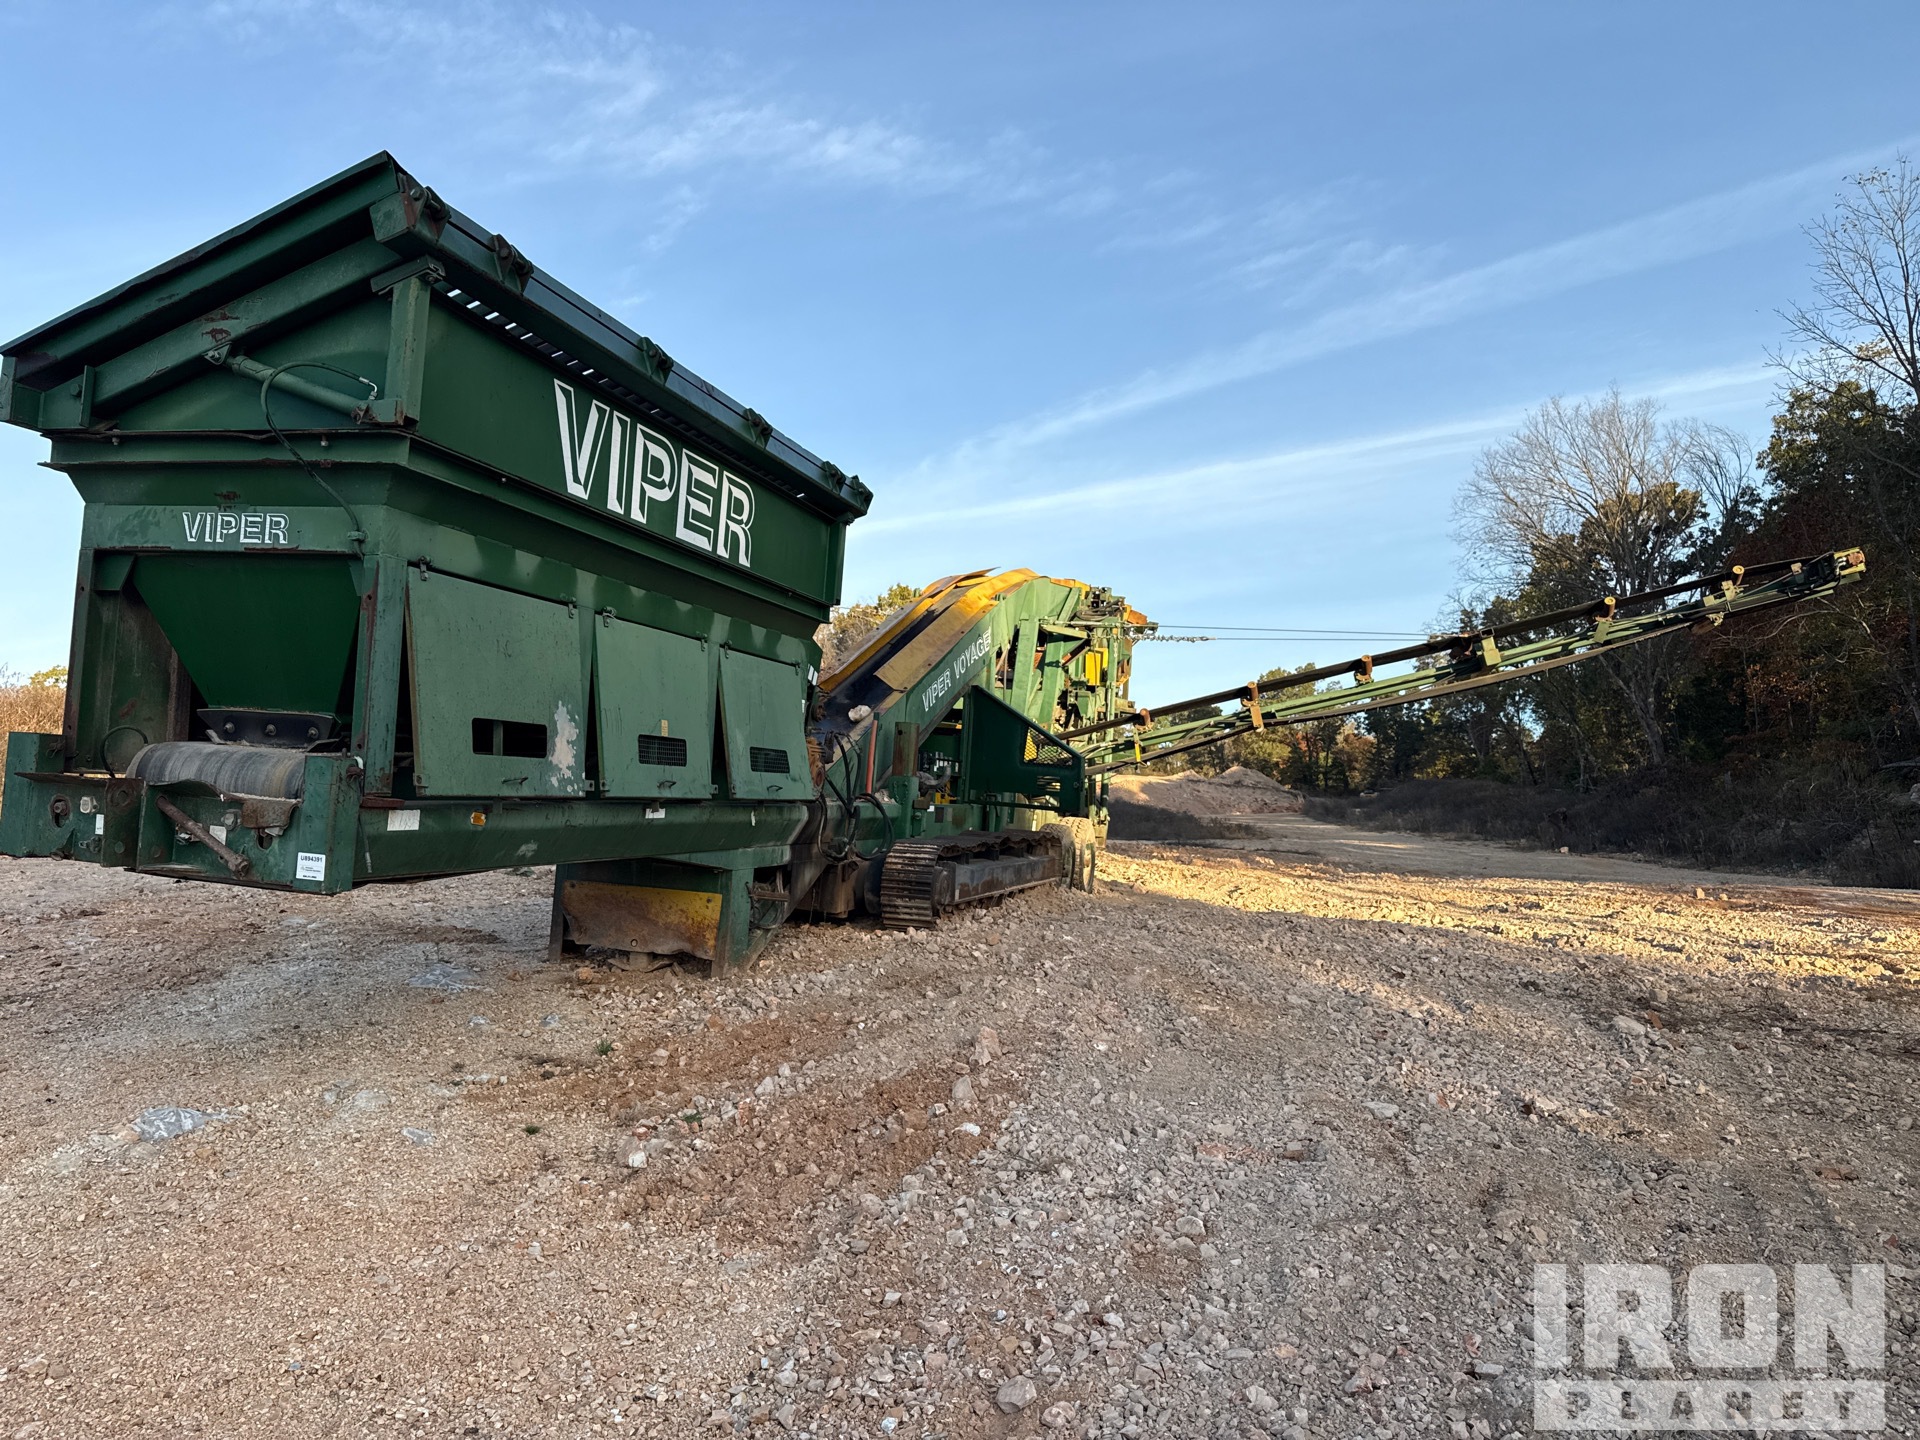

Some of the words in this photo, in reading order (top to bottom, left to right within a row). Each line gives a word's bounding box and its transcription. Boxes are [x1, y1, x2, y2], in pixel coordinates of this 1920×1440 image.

[553, 378, 755, 568] VIPER
[182, 512, 290, 544] VIPER
[921, 668, 952, 712] VIPER
[953, 626, 992, 679] VOYAGE
